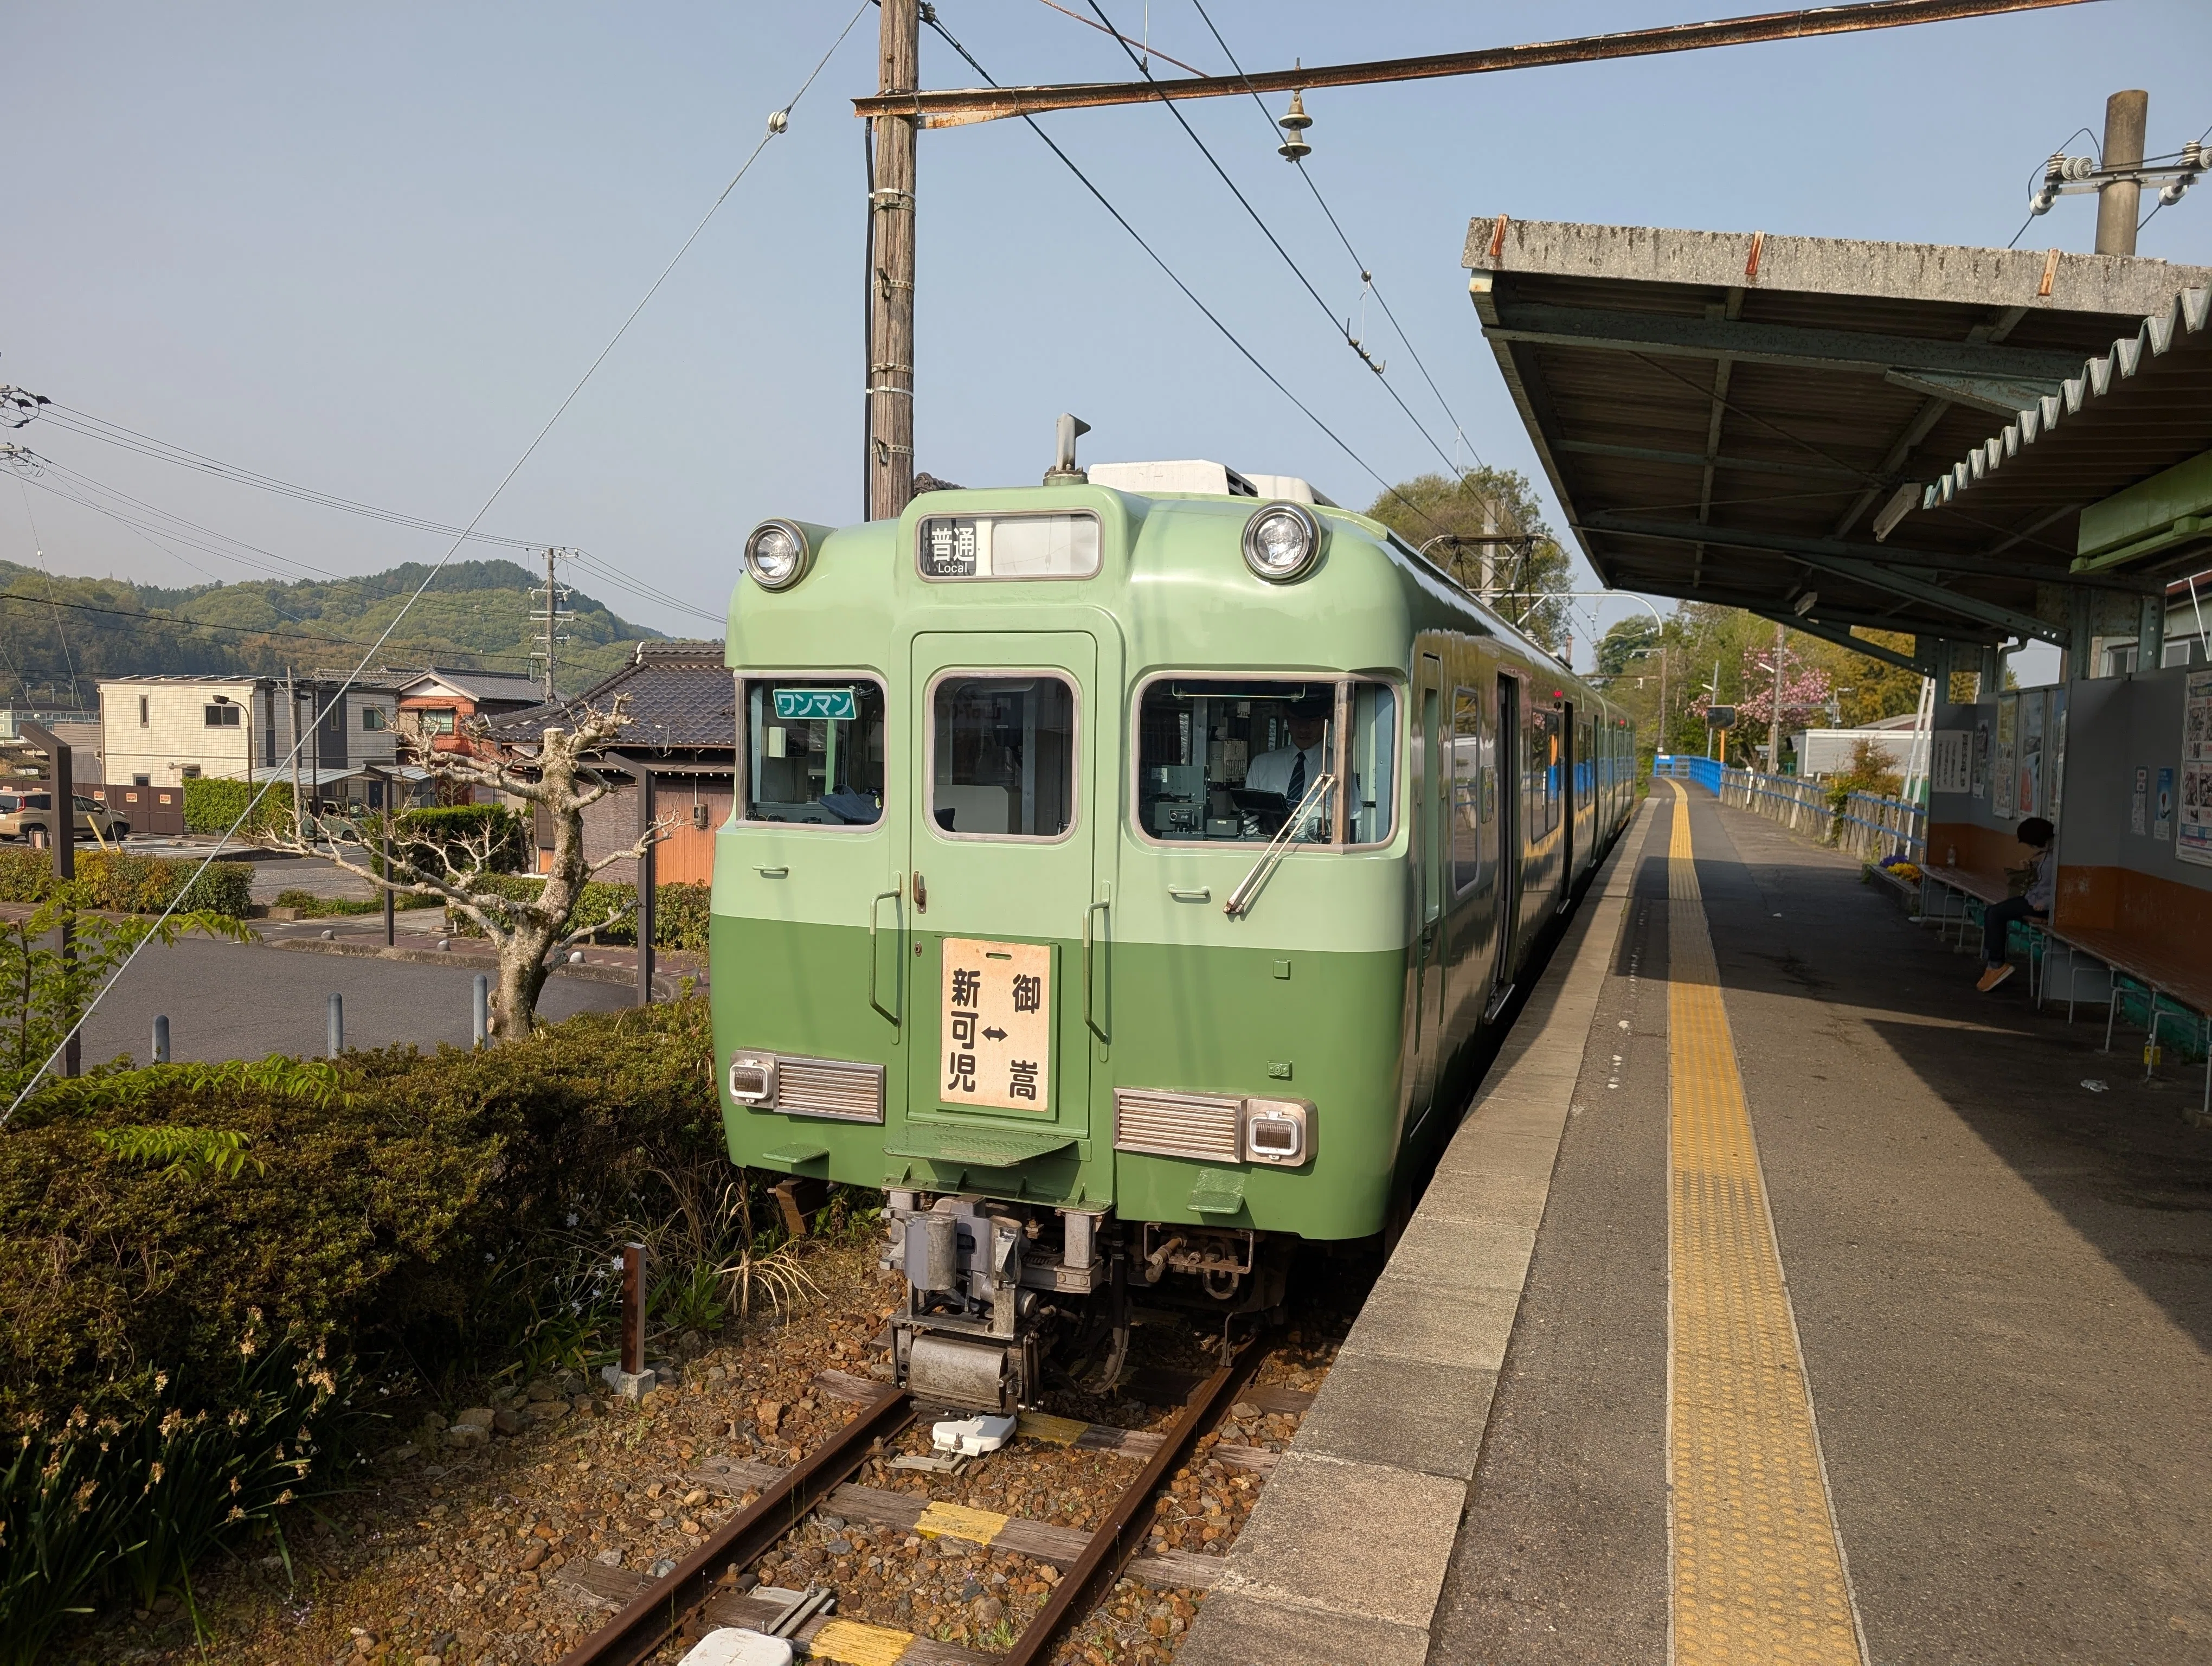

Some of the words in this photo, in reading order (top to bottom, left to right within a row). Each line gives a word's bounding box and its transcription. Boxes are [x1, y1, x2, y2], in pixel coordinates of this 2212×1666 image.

[931, 527, 975, 562] 普通
[938, 562, 968, 573] Local
[777, 694, 851, 715] ワンマン
[948, 967, 981, 1092] 新可児
[1009, 973, 1041, 1101] 御嵩
